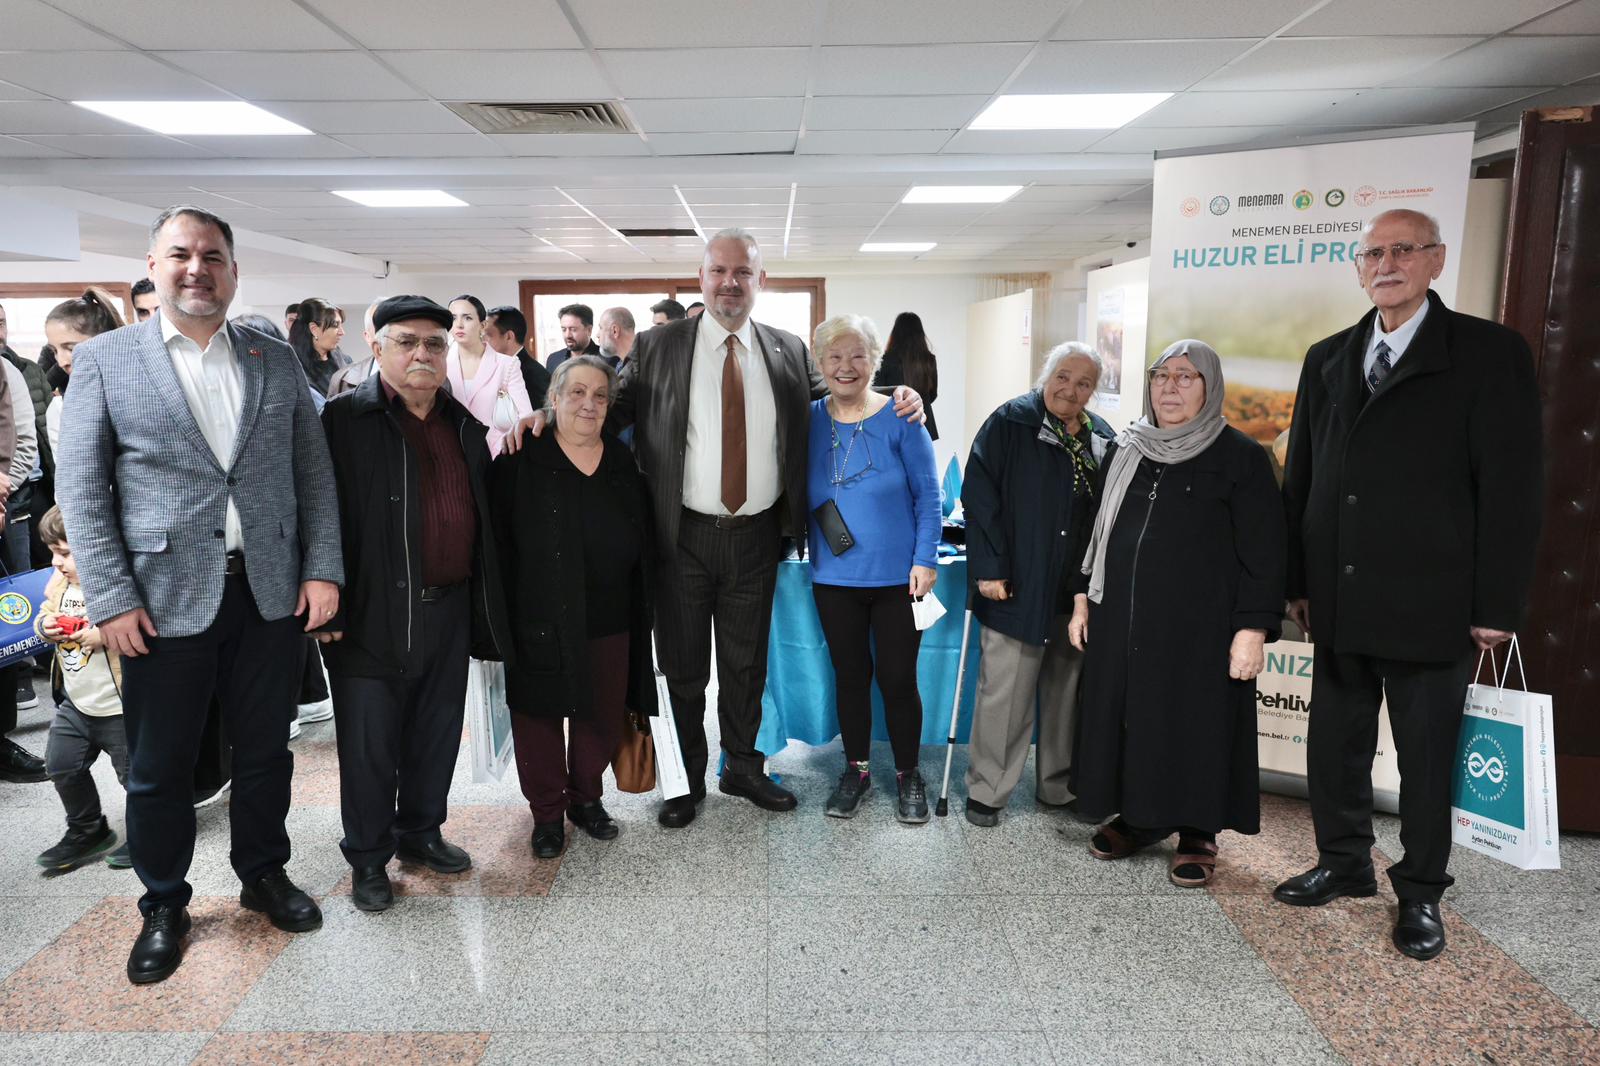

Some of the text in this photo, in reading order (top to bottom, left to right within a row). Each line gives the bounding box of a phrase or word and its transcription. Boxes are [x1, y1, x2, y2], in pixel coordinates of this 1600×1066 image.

[1238, 193, 1284, 207] menemen
[1232, 221, 1362, 238] MENEMEN BELEDİYESİ
[1173, 246, 1257, 269] HUZUR
[1264, 239, 1303, 265] ELİ
[1258, 708, 1309, 722] Belediye Ba
[1457, 816, 1518, 845] HEP YANINIZDAYIZ
